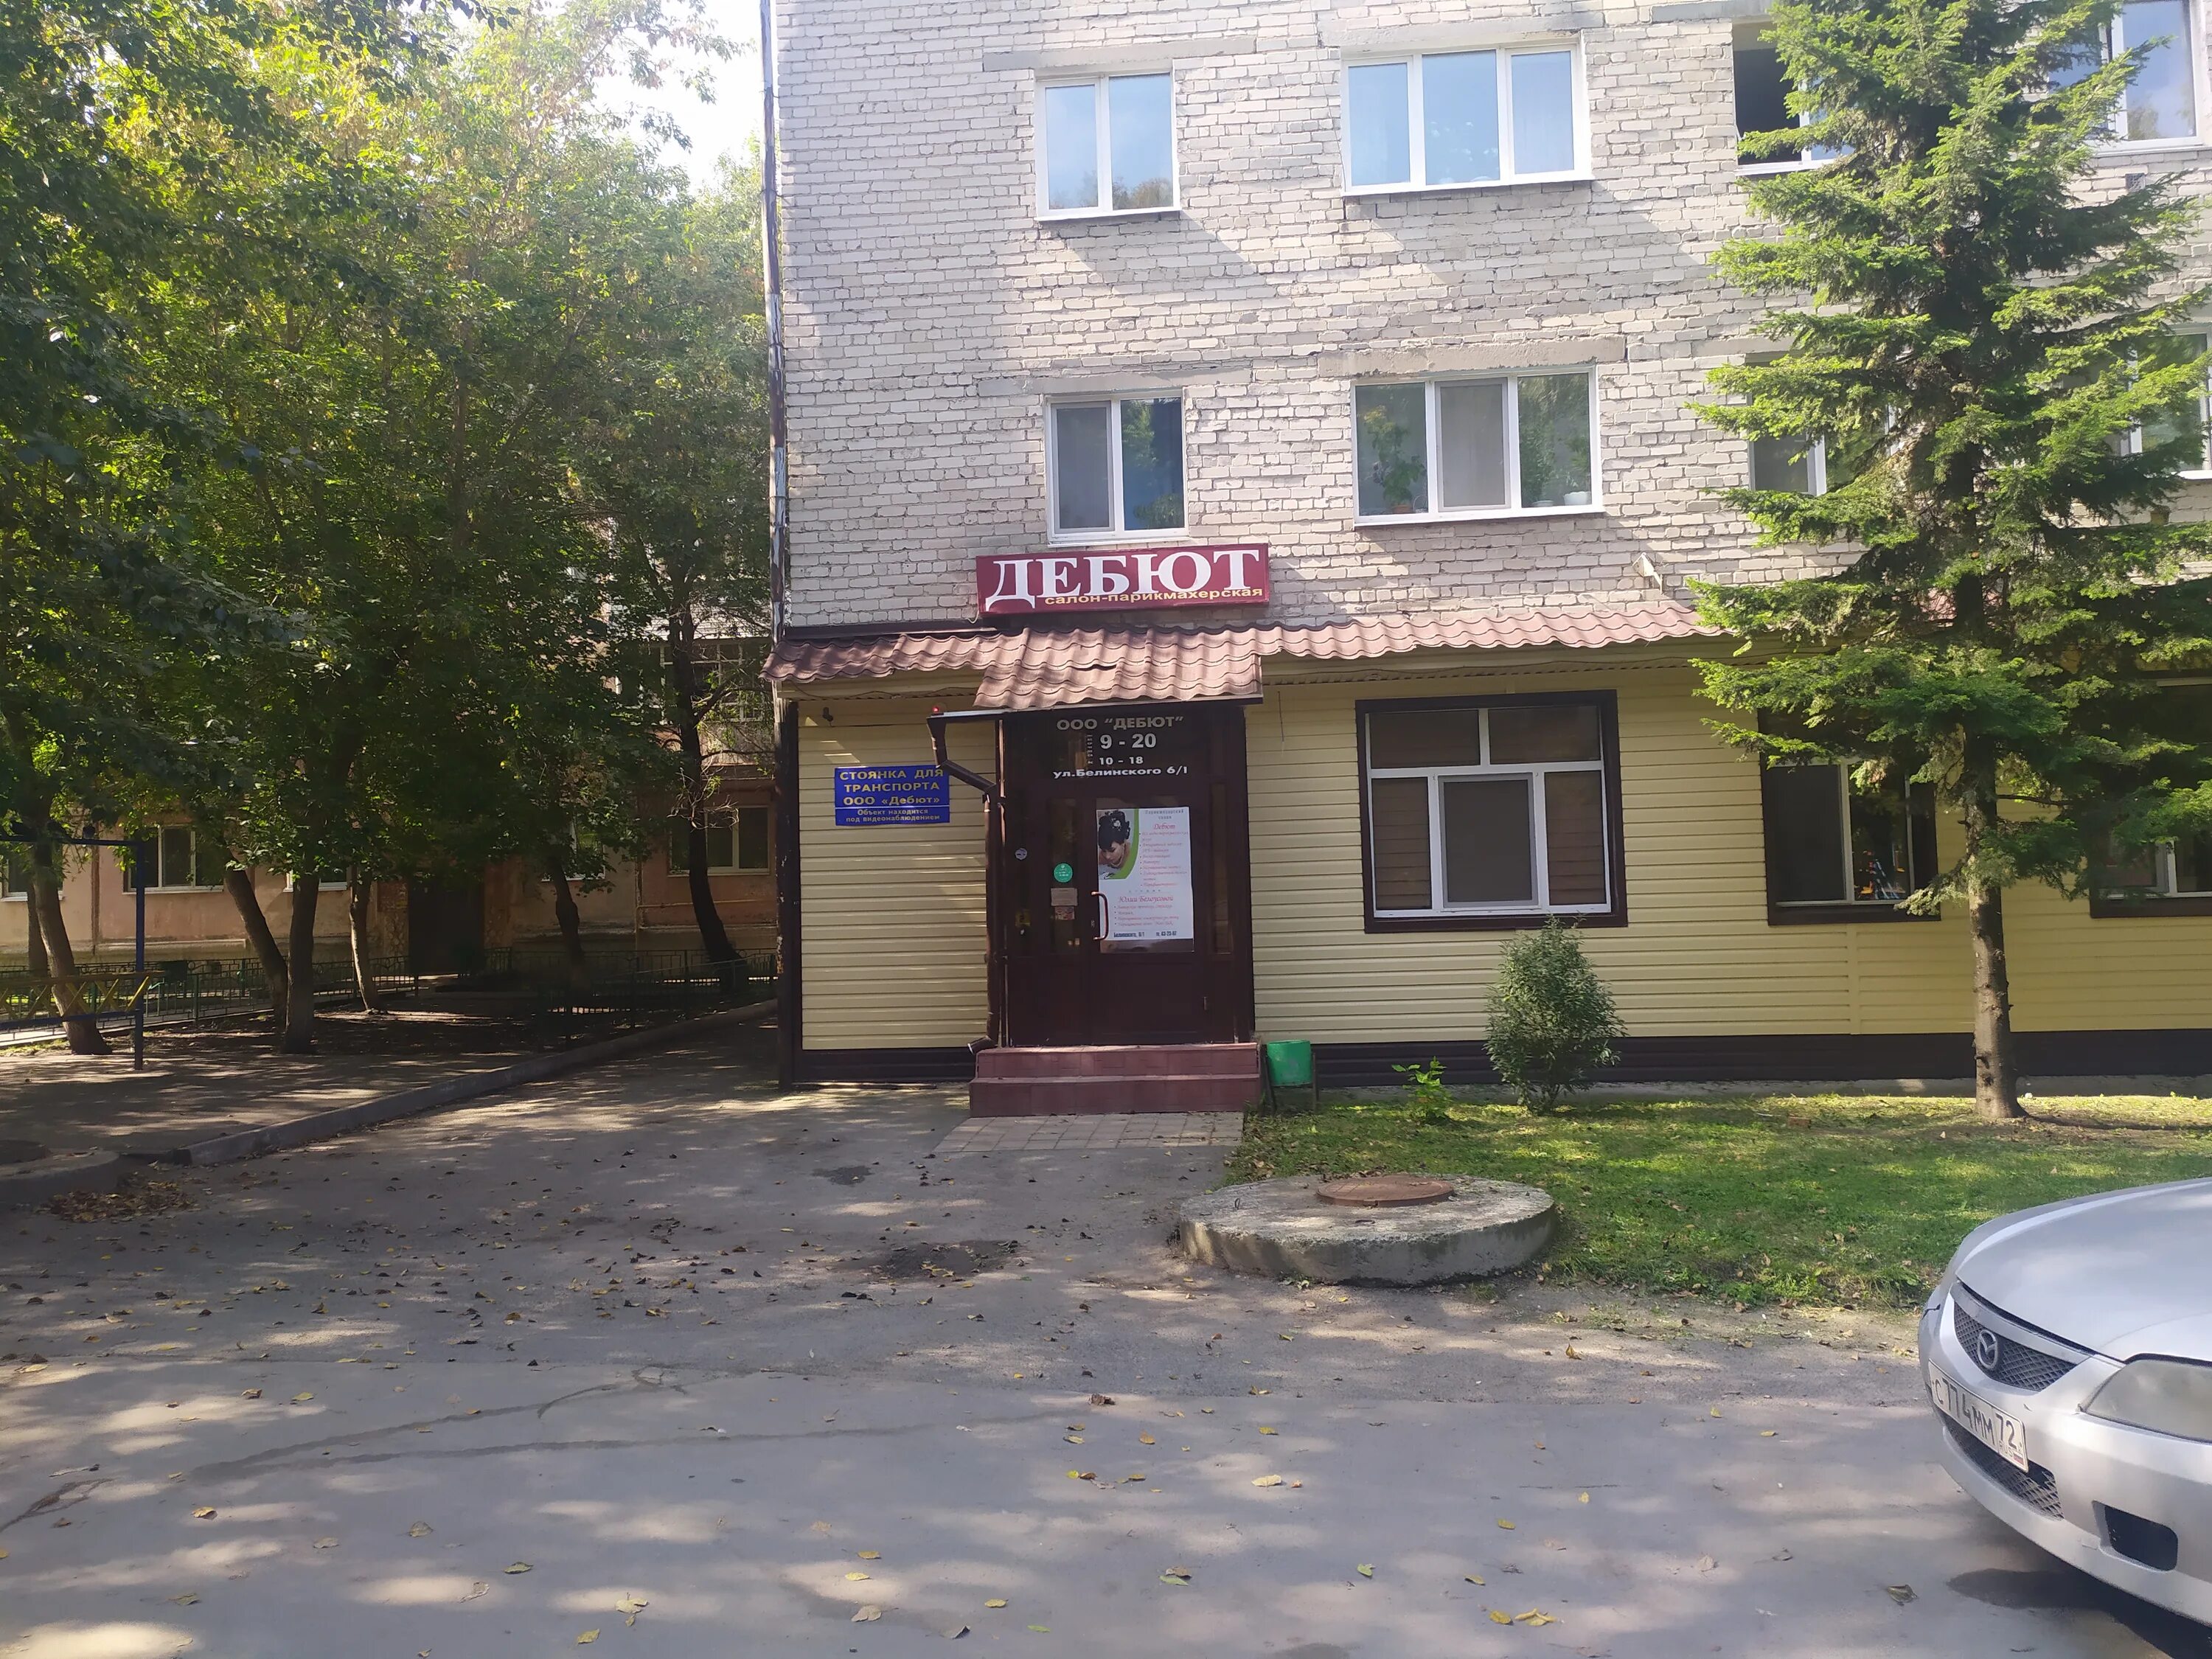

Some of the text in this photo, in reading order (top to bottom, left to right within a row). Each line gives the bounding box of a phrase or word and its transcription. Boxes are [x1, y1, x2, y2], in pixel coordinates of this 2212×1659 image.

[985, 549, 1260, 612] ДЕБЮТ
[1044, 588, 1263, 605] салон-парикмахерская
[1057, 718, 1098, 731] ООО
[1099, 734, 1113, 750] 9
[1132, 733, 1157, 749] 20
[1099, 757, 1113, 766] 10
[1129, 757, 1144, 765] 18
[840, 768, 944, 780] СТОЯНКА ДЛЯ
[1166, 765, 1188, 776] 6/1
[844, 782, 940, 793] ТРАНСПОРТА
[843, 796, 940, 806] ООО «Дебют»
[863, 815, 941, 823] видеонаблюдением
[1995, 1412, 2017, 1450] 72
[1999, 1440, 2014, 1458] RUS
